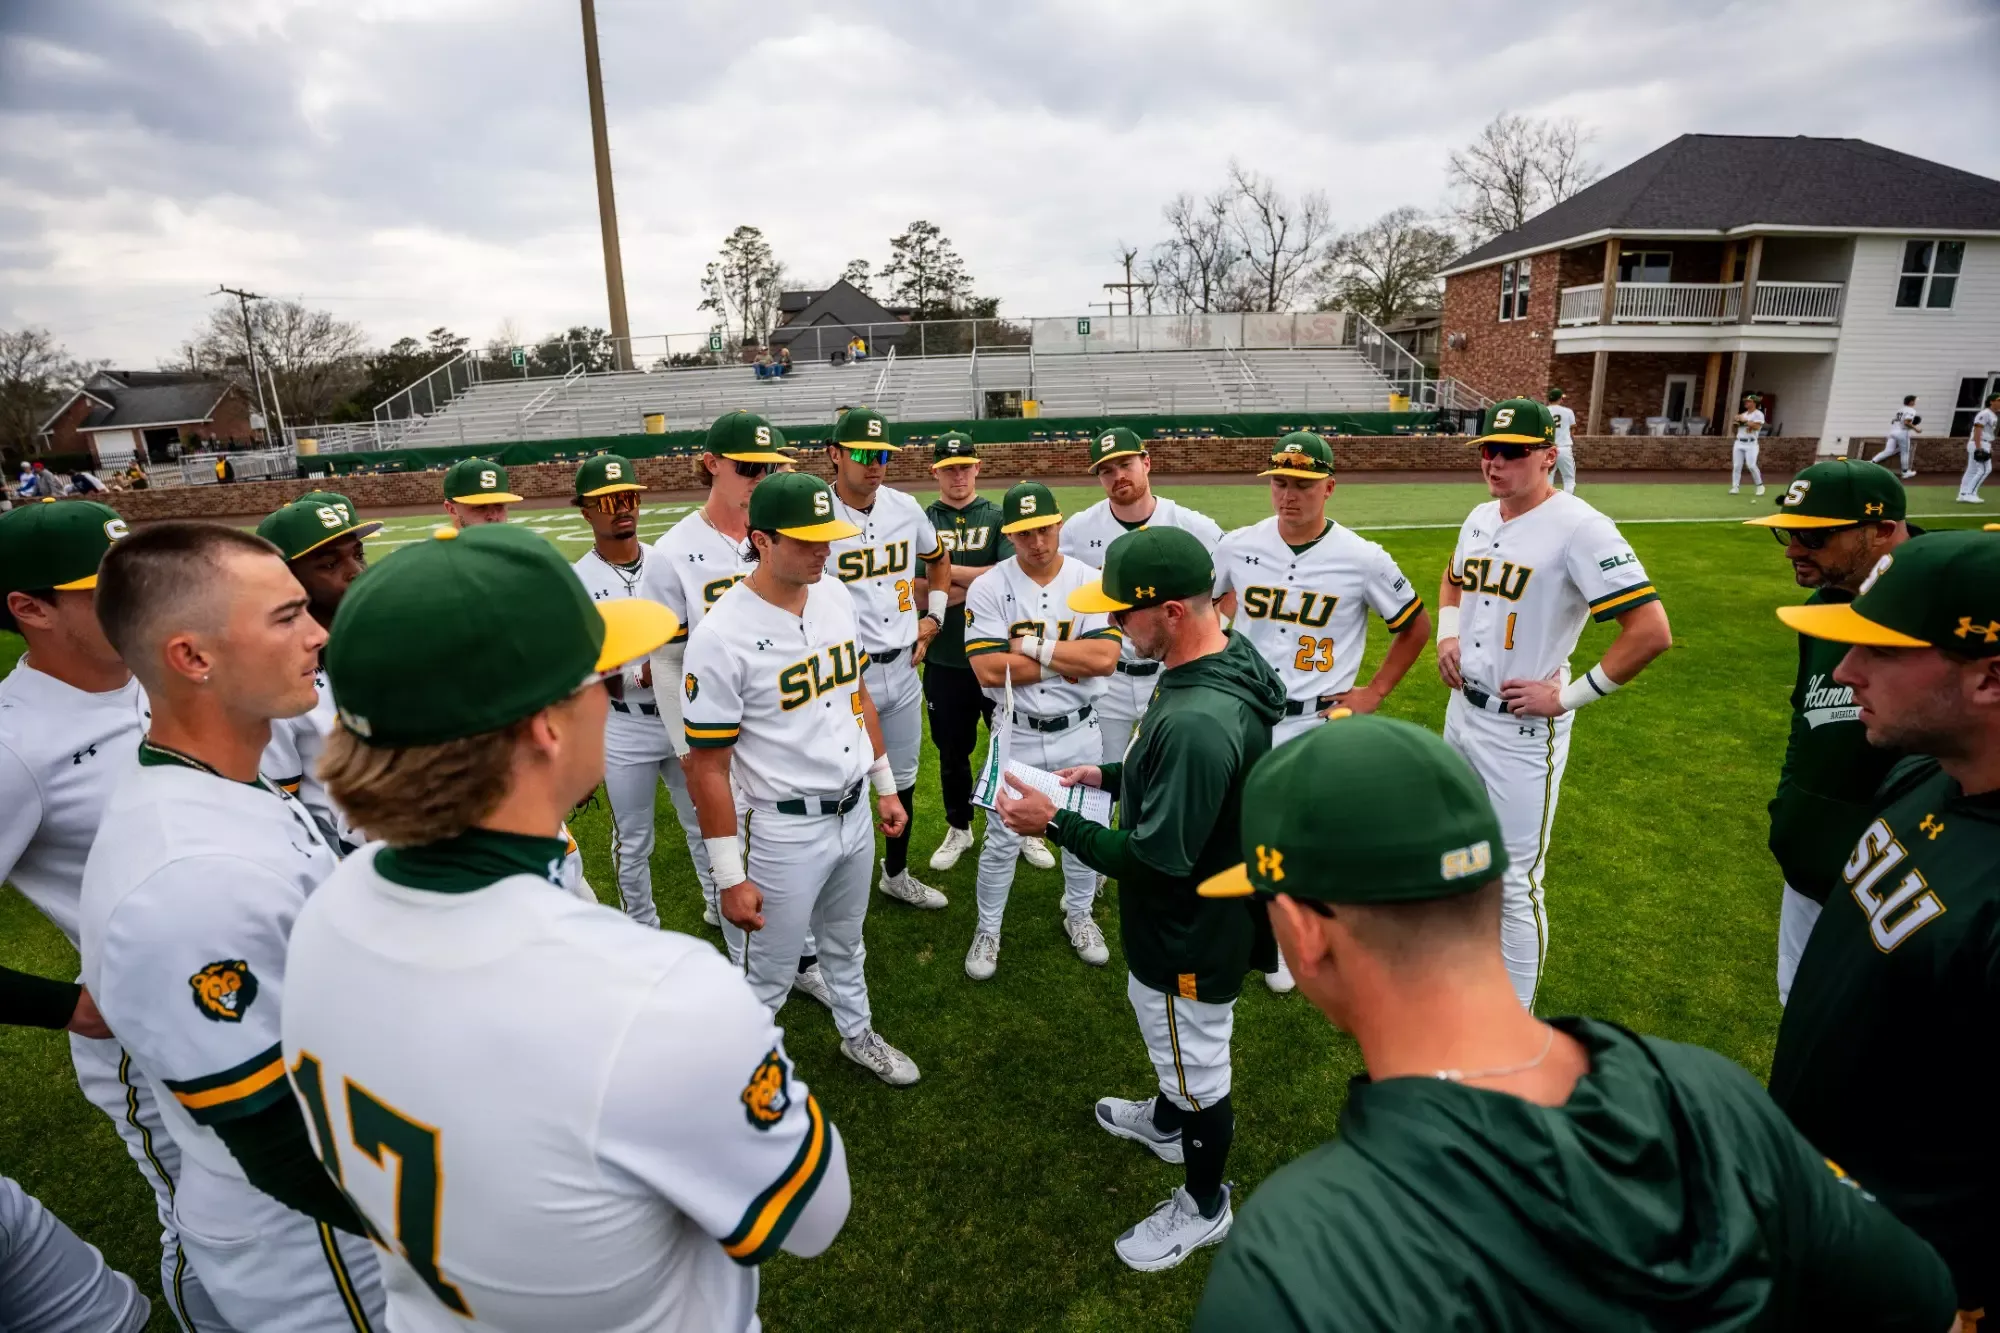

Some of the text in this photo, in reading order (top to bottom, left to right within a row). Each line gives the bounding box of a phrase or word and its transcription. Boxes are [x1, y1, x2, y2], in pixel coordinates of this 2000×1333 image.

[1080, 322, 1088, 333] H
[712, 337, 720, 349] G
[867, 419, 882, 437] S
[1493, 408, 1515, 429] S
[755, 426, 771, 446] S
[1101, 434, 1116, 452] S
[480, 470, 497, 489] S
[605, 462, 622, 480] S
[814, 491, 830, 516] S
[1019, 494, 1037, 515] S
[1784, 480, 1811, 506] S
[316, 506, 343, 529] S
[936, 526, 990, 552] SLU
[838, 540, 909, 583] SLU
[1461, 557, 1534, 602] SLU
[1244, 586, 1340, 628] SLU
[1504, 612, 1518, 650] 1
[1293, 634, 1335, 672] 23
[778, 639, 858, 712] SLU
[1440, 840, 1492, 880] SLU
[1842, 817, 1948, 955] SLU
[289, 1047, 476, 1320] 17
